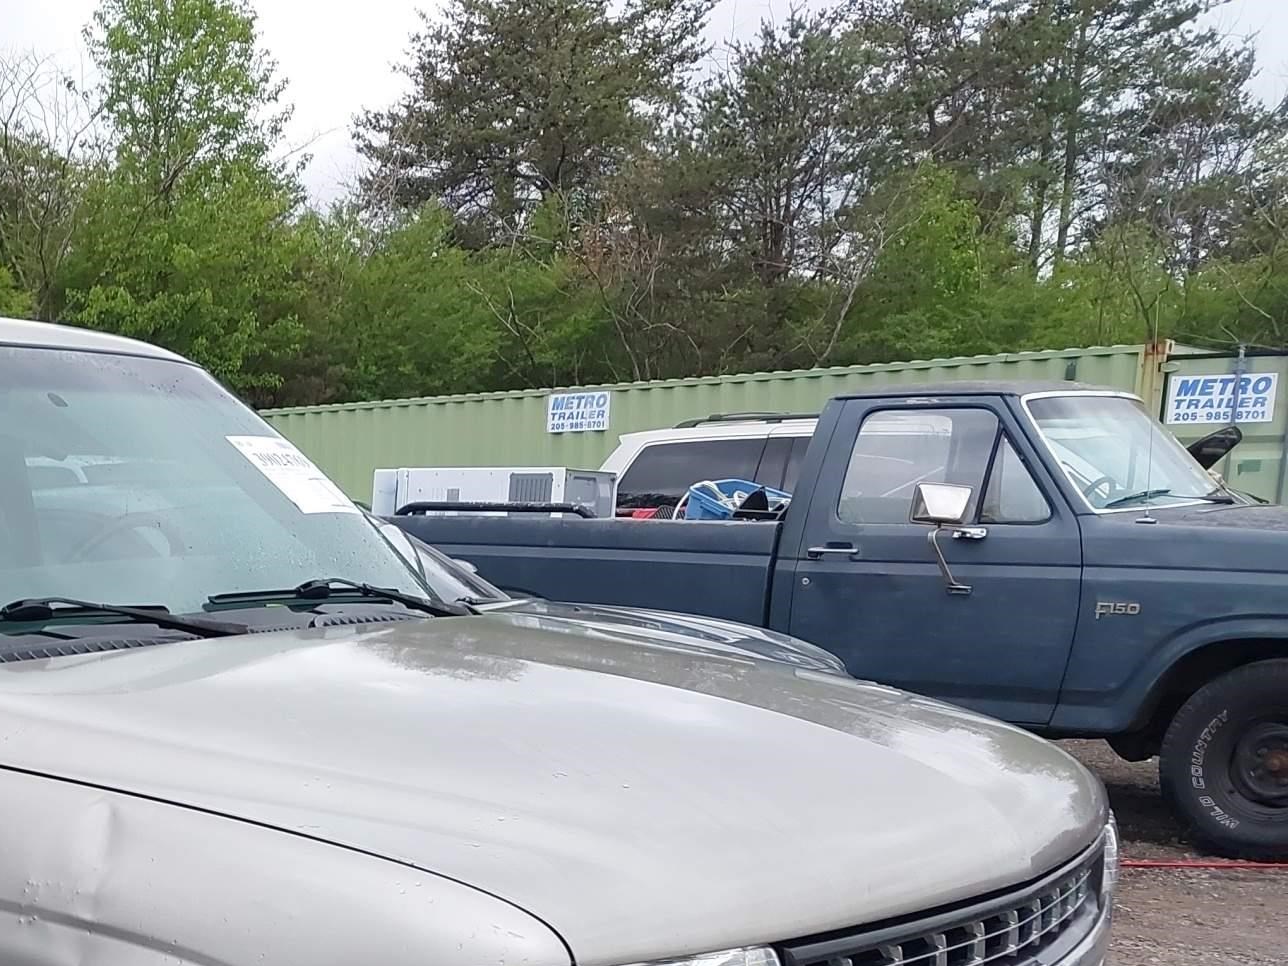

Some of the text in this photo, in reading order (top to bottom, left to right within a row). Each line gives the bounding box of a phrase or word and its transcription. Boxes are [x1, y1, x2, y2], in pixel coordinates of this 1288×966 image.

[1176, 376, 1273, 397] METRO
[551, 394, 608, 411] METRO
[1174, 396, 1268, 410] TRAILER
[550, 409, 606, 421] TRAILER
[1174, 410, 1266, 421] 205-9858701
[1191, 709, 1240, 829] WILD COUNTRY
